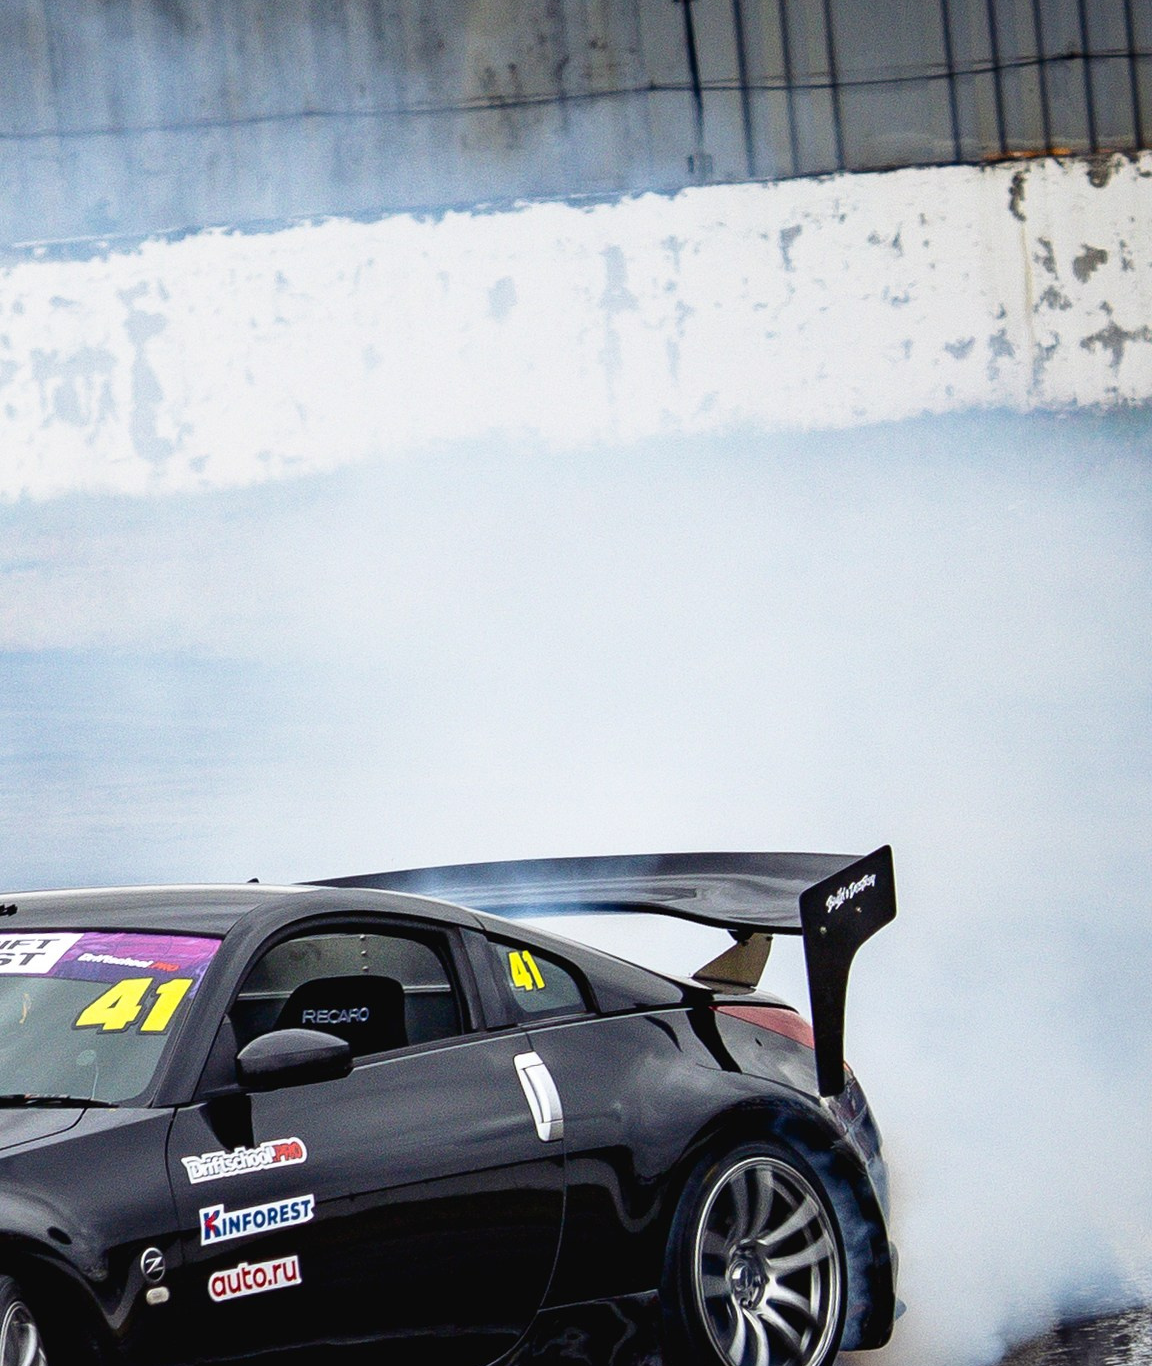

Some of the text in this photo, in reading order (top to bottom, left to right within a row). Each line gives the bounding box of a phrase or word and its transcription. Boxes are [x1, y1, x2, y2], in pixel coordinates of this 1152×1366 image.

[508, 949, 546, 991] 41
[73, 976, 194, 1033] 41
[302, 1007, 370, 1024] RECARO
[203, 1199, 311, 1241] KINFOREST
[211, 1260, 298, 1298] auto.ru
